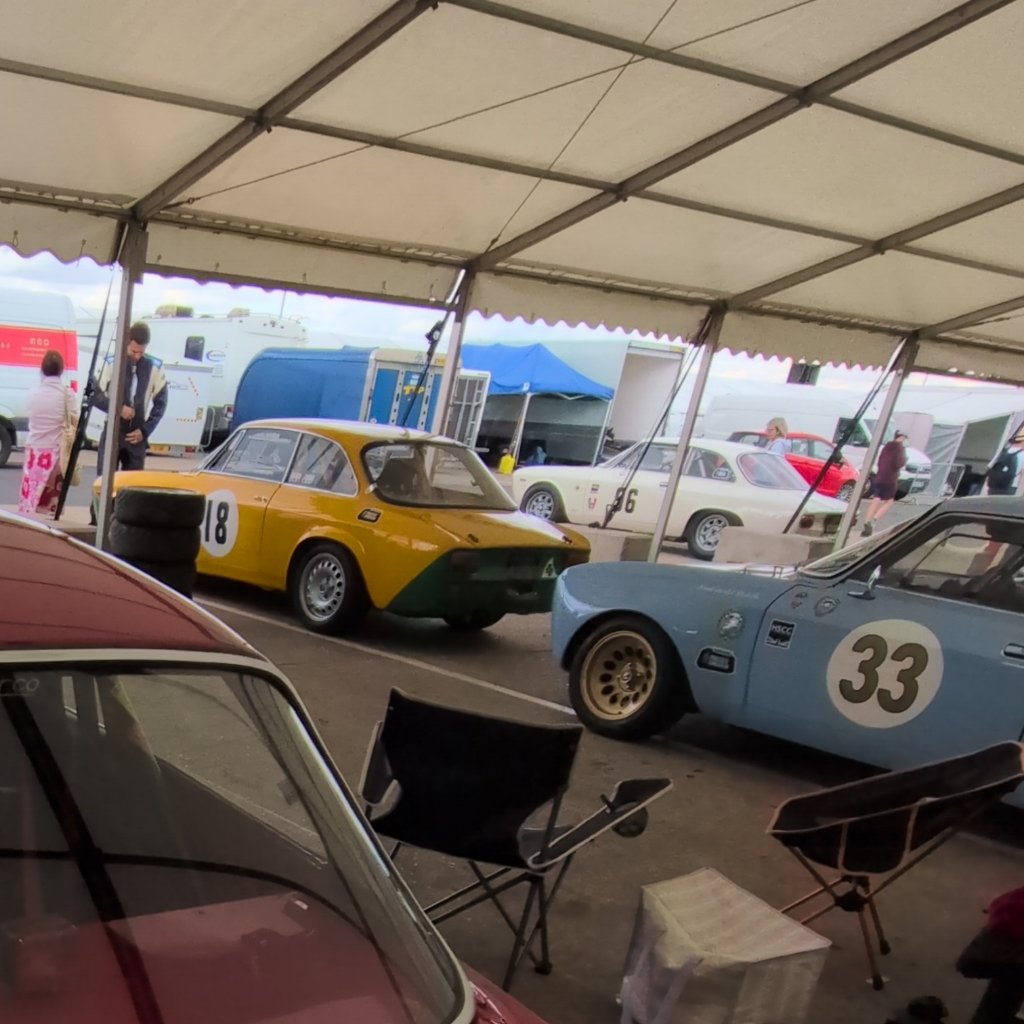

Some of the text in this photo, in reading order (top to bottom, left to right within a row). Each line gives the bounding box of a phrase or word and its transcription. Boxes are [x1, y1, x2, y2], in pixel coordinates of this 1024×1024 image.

[205, 500, 230, 545] 18
[772, 624, 793, 636] HSCC
[839, 634, 929, 714] 33
